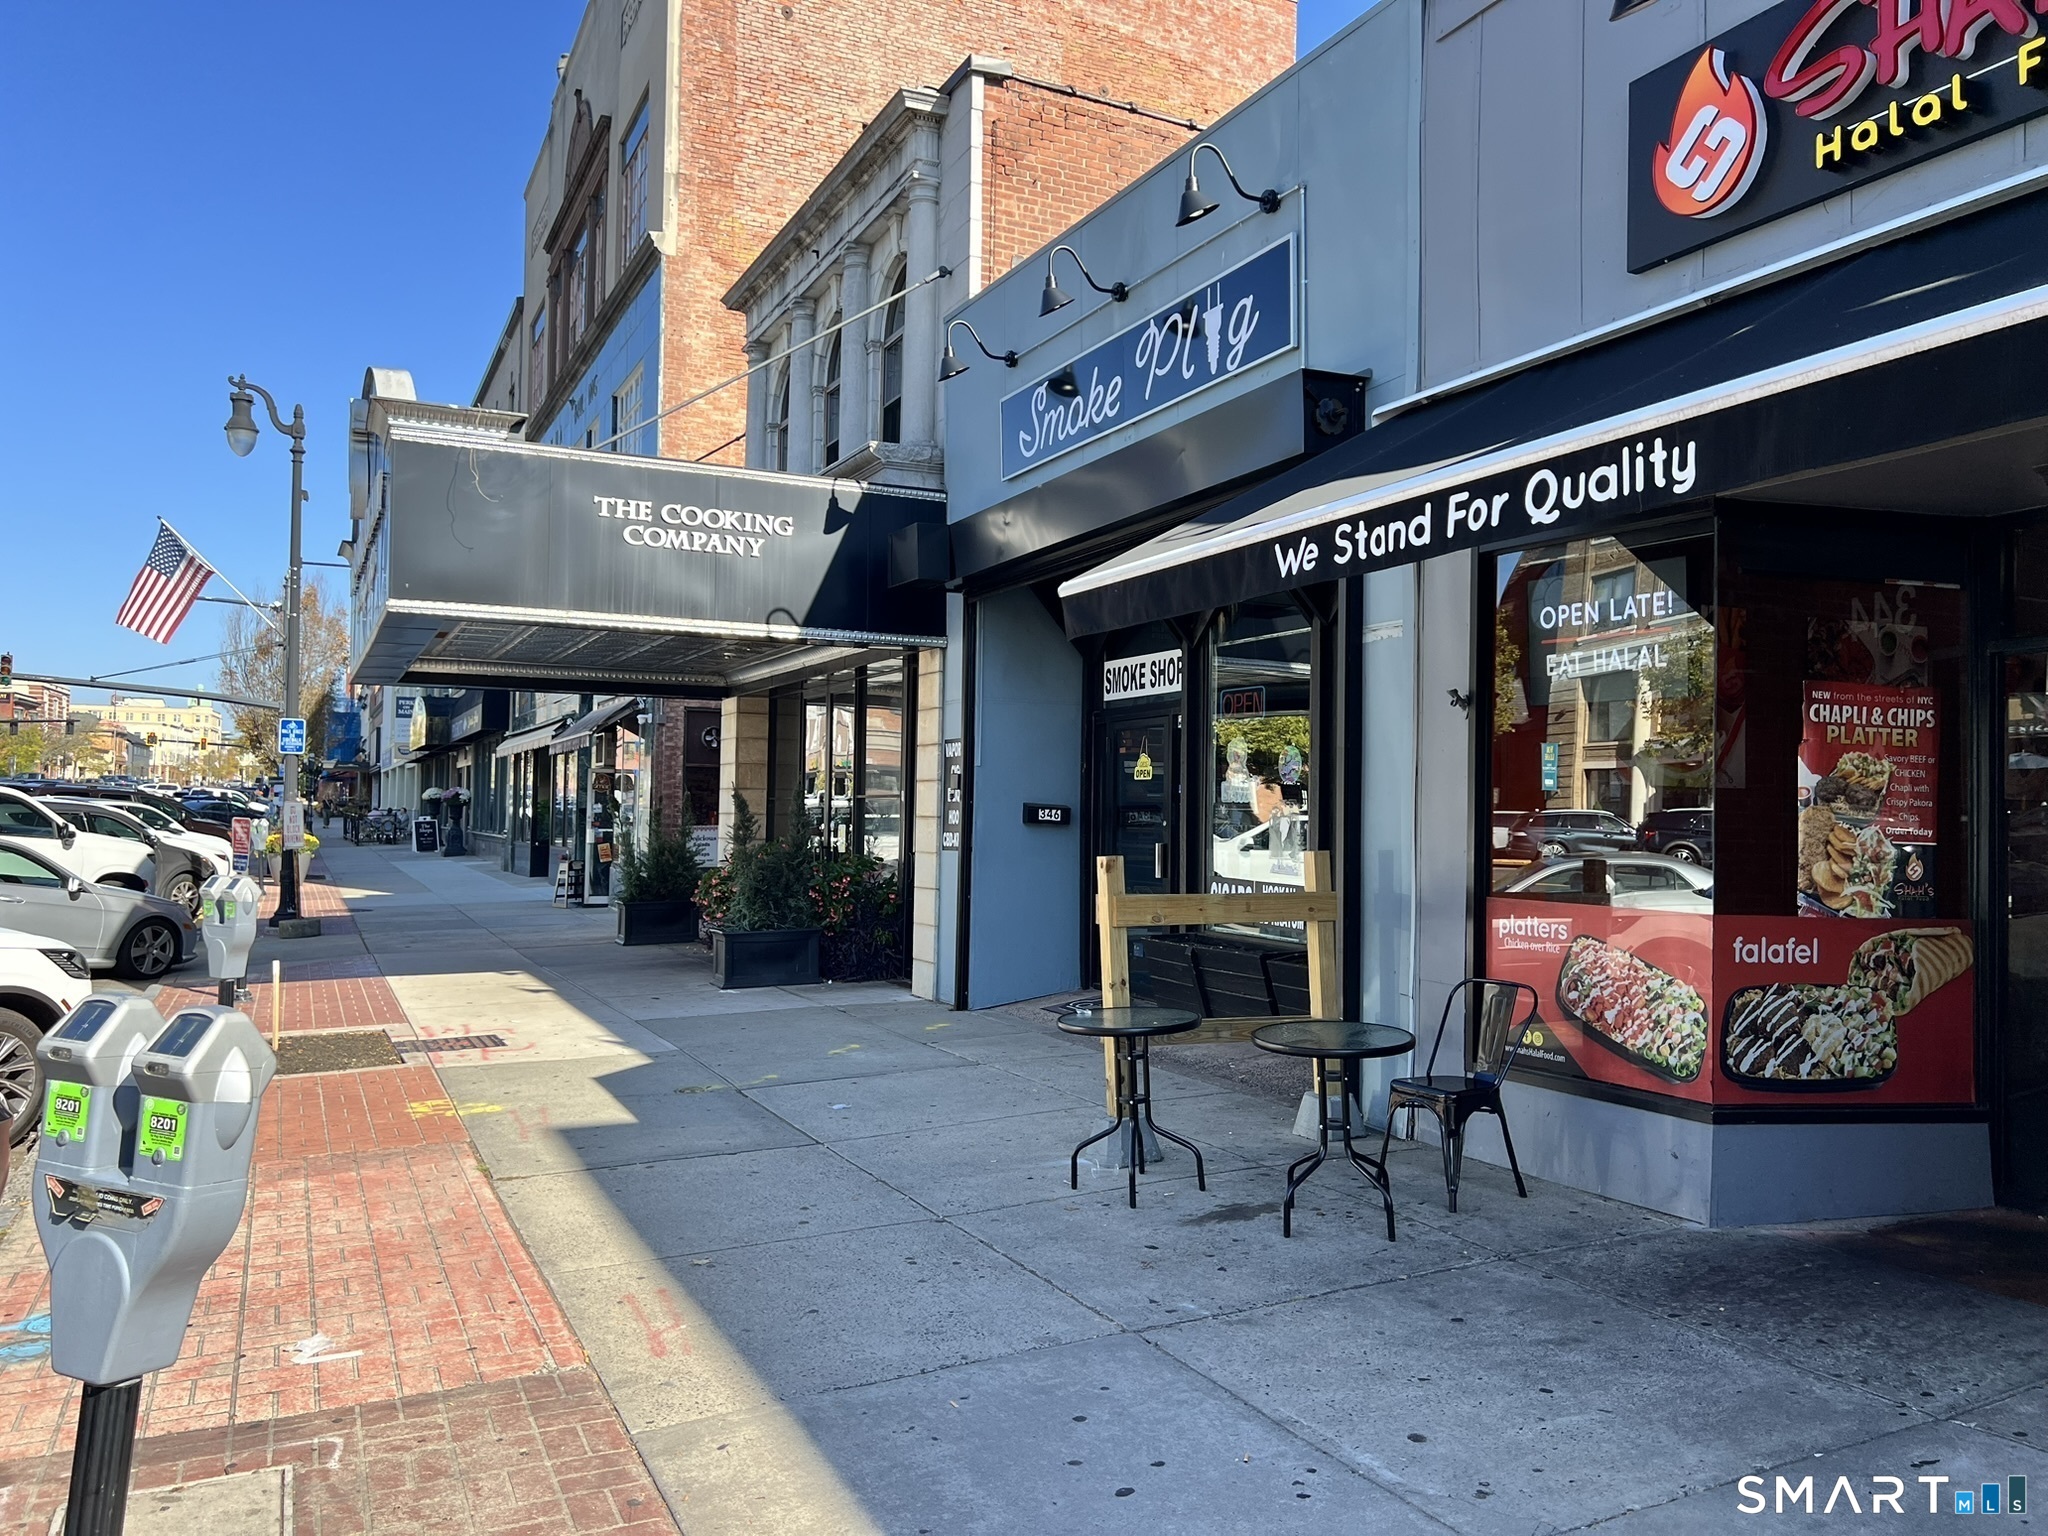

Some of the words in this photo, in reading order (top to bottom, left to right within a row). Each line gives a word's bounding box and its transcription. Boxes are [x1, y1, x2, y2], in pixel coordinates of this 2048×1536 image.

[1815, 73, 1968, 169] Halal
[1019, 366, 1122, 458] Smoke
[593, 495, 653, 522] THE
[660, 503, 795, 537] COOKING
[1274, 535, 1319, 578] We
[1334, 502, 1432, 565] Stand
[1447, 491, 1510, 538] For
[1524, 437, 1697, 525] Quality
[622, 524, 766, 557] COMPANY
[1540, 600, 1599, 629] OPEN
[1610, 590, 1673, 621] LATE!
[1546, 651, 1584, 677] EAT
[1593, 643, 1668, 673] HALAL
[1105, 662, 1146, 695] SMOKE
[1222, 691, 1264, 717] OPEN
[1812, 690, 1831, 700] NEW
[1833, 691, 1853, 701] from
[1856, 693, 1872, 702] the
[1874, 694, 1904, 704] streets
[1906, 696, 1915, 705] of
[1917, 696, 1934, 705] NYC
[1809, 703, 1868, 725] CHAPLI
[1871, 706, 1884, 726] &
[1887, 707, 1936, 728] CHIPS
[1826, 725, 1919, 748] PLATTER
[1884, 754, 1909, 764] Savory
[1910, 755, 1927, 764] BEEF
[1136, 769, 1151, 778] OPEN
[1894, 768, 1926, 778] CHICKEN
[1890, 783, 1912, 795] Chapli
[1913, 784, 1930, 793] with
[1886, 797, 1908, 808] Crispy
[1909, 798, 1933, 808] Pakora
[1039, 809, 1060, 820] 346
[1898, 812, 1920, 823] Chips.
[1909, 828, 1933, 838] Today
[1499, 914, 1568, 940] platters
[1504, 937, 1529, 949] Chicken
[1530, 943, 1544, 952] over
[1546, 943, 1560, 954] Rice
[1732, 936, 1818, 964] falafel
[55, 1098, 80, 1113] 8201
[150, 1116, 177, 1131] 8201
